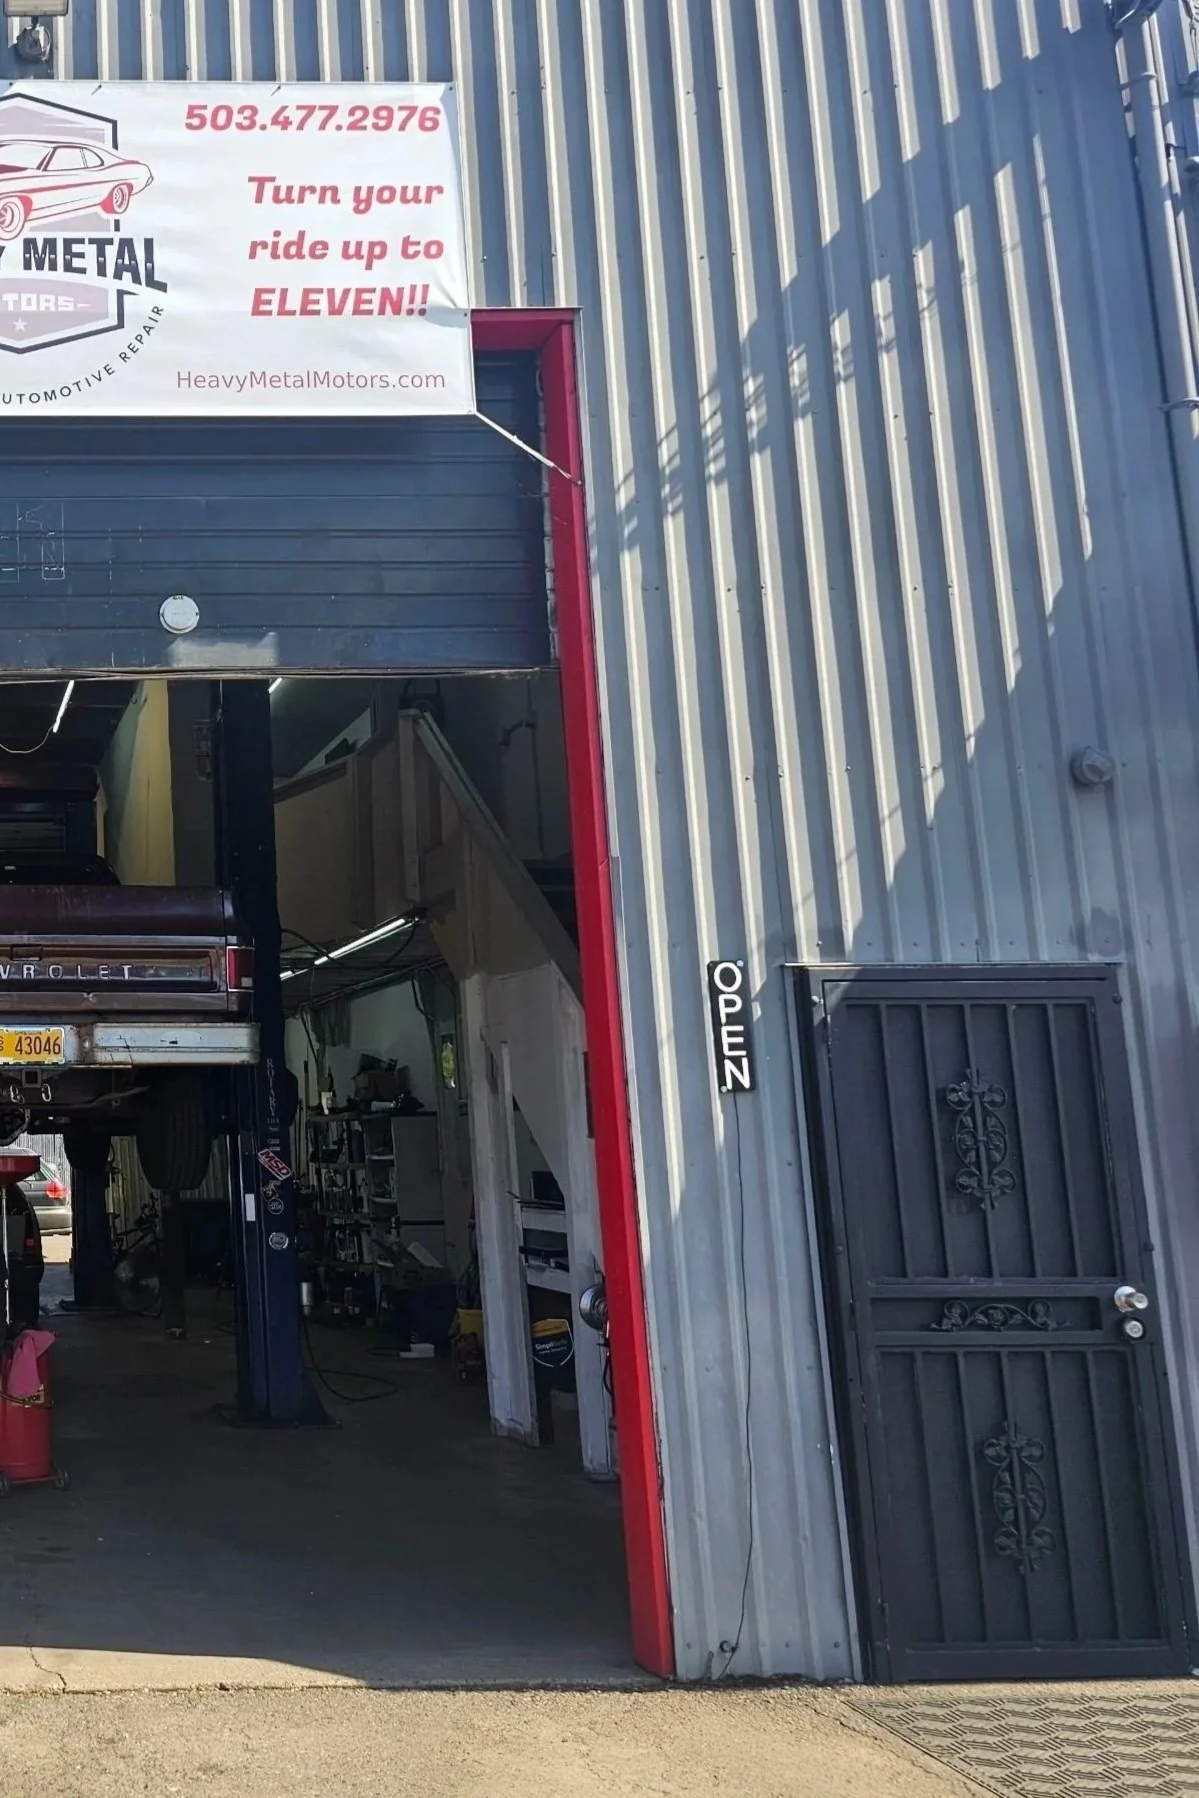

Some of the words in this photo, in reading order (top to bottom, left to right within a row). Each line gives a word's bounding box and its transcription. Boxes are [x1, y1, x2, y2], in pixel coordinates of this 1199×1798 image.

[184, 103, 441, 133] 503.477.2976
[247, 175, 341, 206] Turn
[352, 182, 444, 215] your
[22, 236, 168, 294] METAL
[248, 229, 330, 261] ride
[341, 237, 386, 271] up
[400, 236, 444, 261] to
[250, 283, 430, 318] ELEVEN!!
[118, 304, 165, 363] REPAIR
[176, 370, 446, 394] HeavyMetalMotors.com
[14, 1035, 61, 1056] 43046
[713, 962, 751, 1090] OPEN
